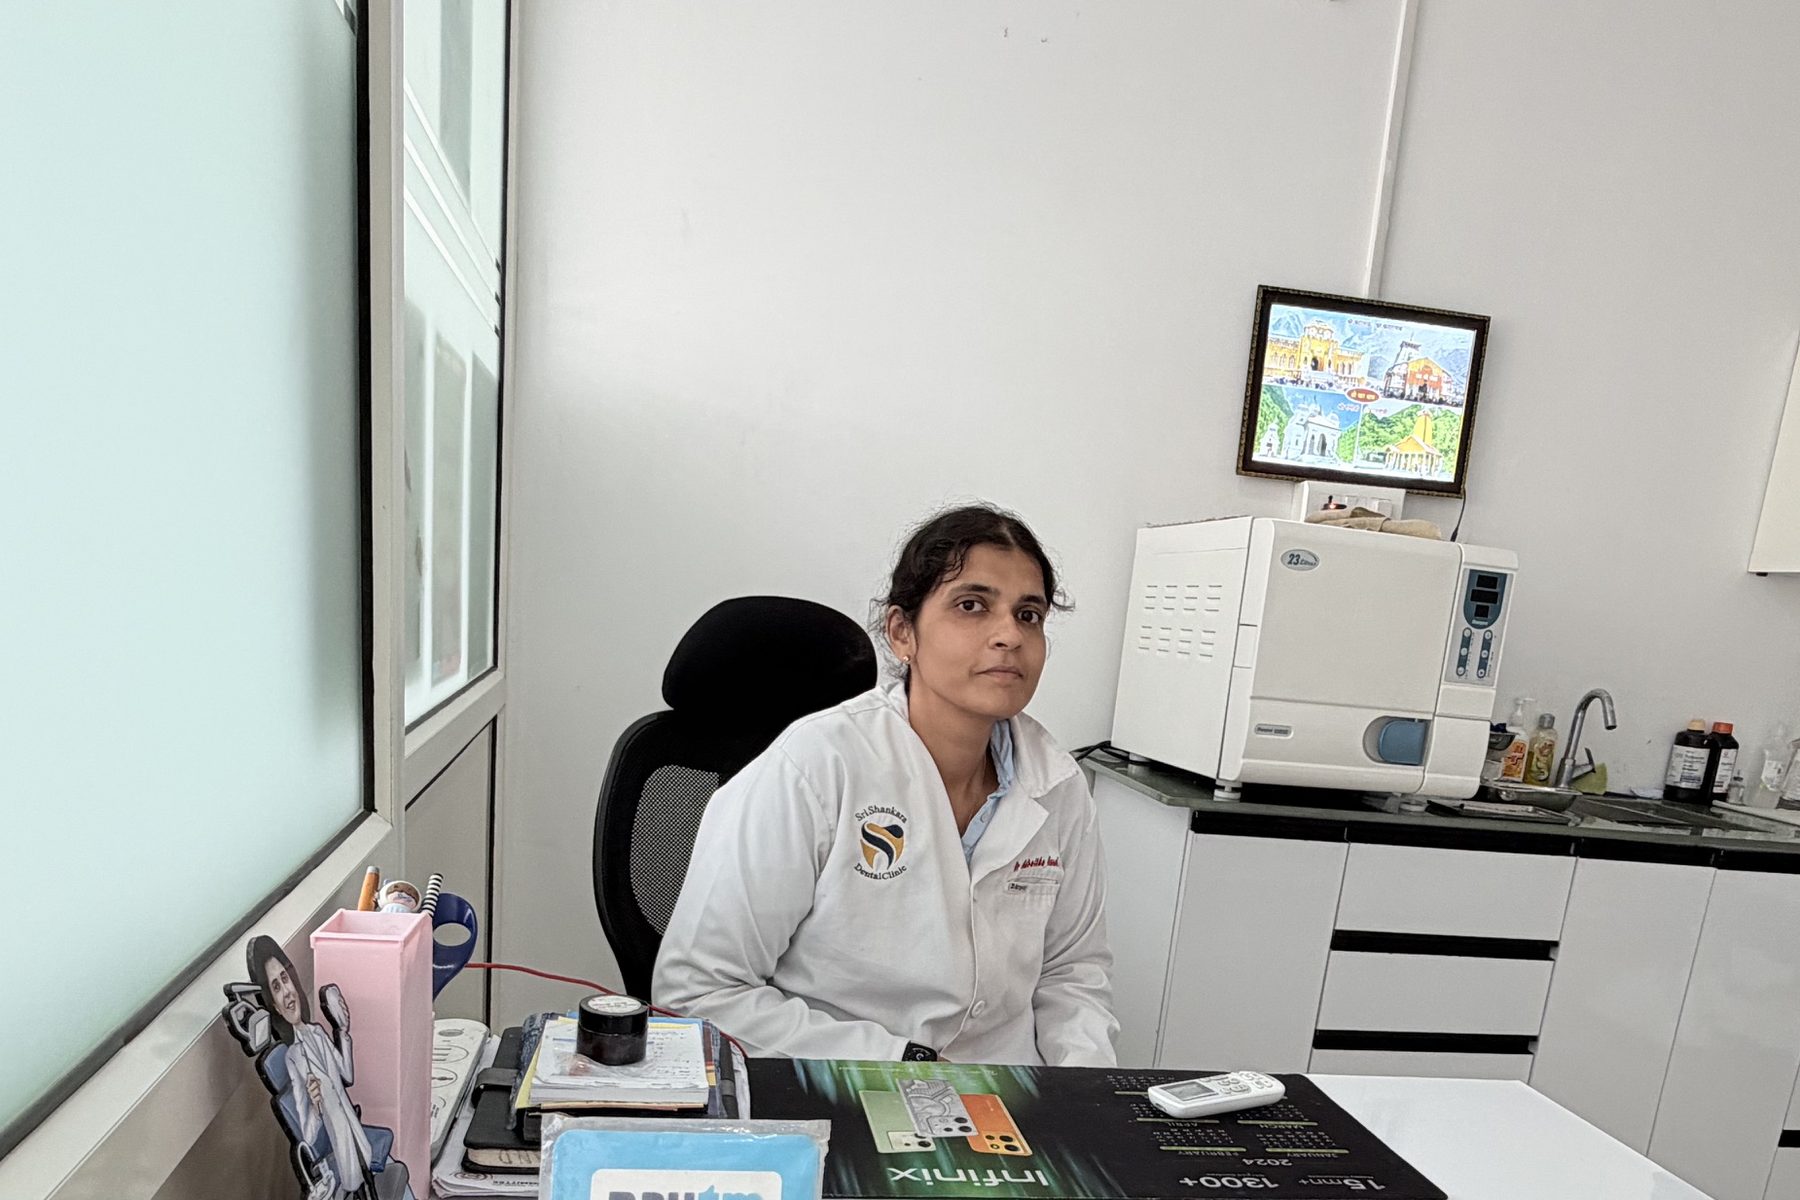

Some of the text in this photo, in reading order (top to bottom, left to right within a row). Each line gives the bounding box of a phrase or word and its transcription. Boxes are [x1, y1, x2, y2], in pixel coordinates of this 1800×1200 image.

[1287, 553, 1300, 565] 23
[1242, 1158, 1293, 1166] 2024
[886, 1167, 1049, 1186] Infinix
[1179, 1176, 1280, 1189] 1300+
[1299, 1178, 1386, 1191] 15mn+
